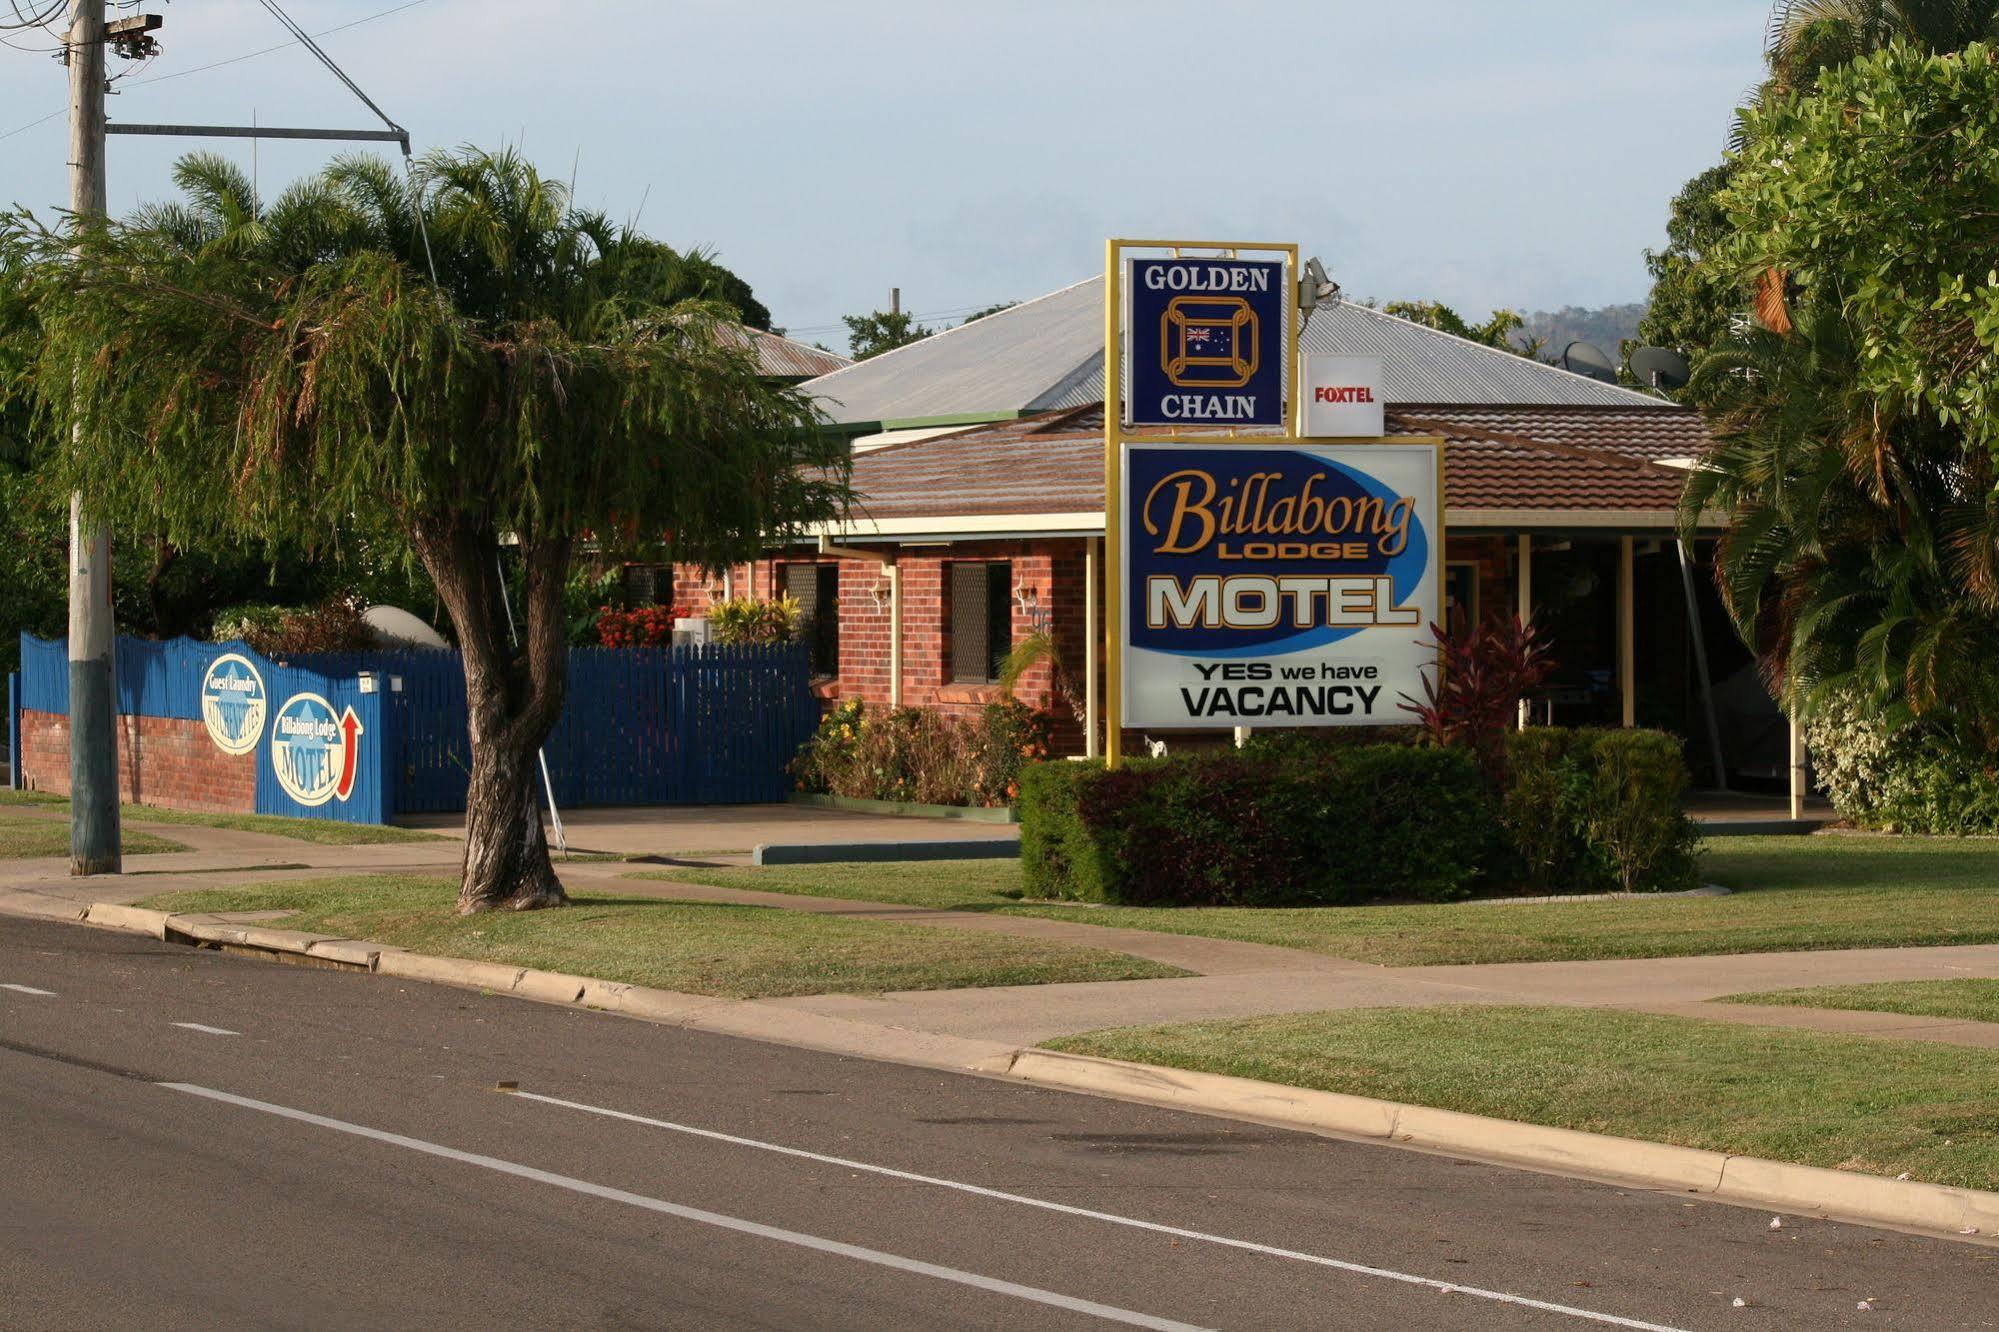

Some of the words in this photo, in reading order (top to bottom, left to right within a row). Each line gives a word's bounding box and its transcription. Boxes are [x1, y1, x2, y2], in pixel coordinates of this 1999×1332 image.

[1145, 264, 1270, 291] GOLDEN
[1160, 395, 1256, 419] CHAIN
[1314, 387, 1374, 403] FOXTEL
[1143, 469, 1416, 554] Billabong
[1218, 543, 1369, 560] LODGE
[1147, 574, 1420, 629] MOTEL
[1193, 663, 1273, 680] YES
[1280, 666, 1316, 680] we
[1321, 663, 1378, 680] have
[209, 673, 229, 690] Guest
[229, 674, 257, 697] Laundry
[1181, 685, 1382, 717] VACANCY
[281, 716, 314, 740] Billabong
[315, 718, 337, 742] Lodge
[282, 746, 336, 791] MOTEL
